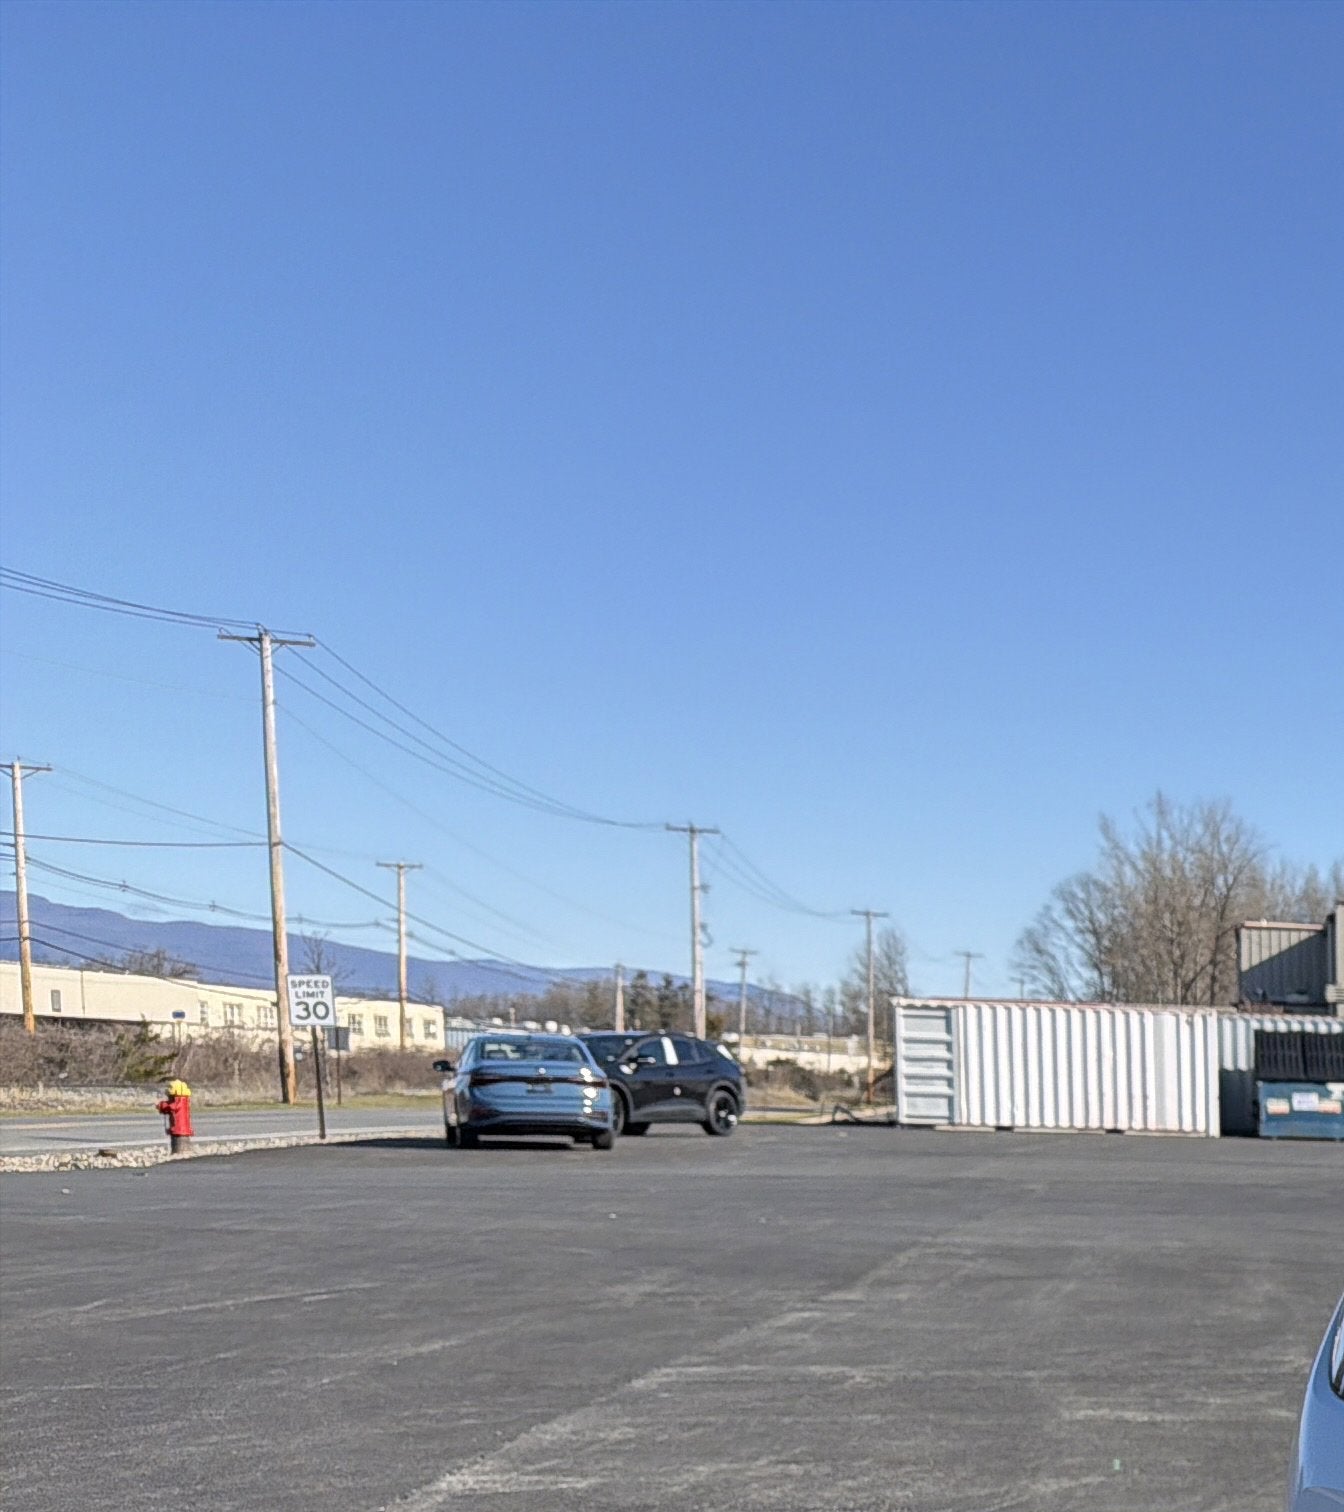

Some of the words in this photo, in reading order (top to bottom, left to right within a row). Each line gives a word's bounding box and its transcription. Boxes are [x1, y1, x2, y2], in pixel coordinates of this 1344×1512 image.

[290, 979, 329, 989] SPEED
[294, 990, 325, 999] LIMIT
[294, 1001, 330, 1021] 30
